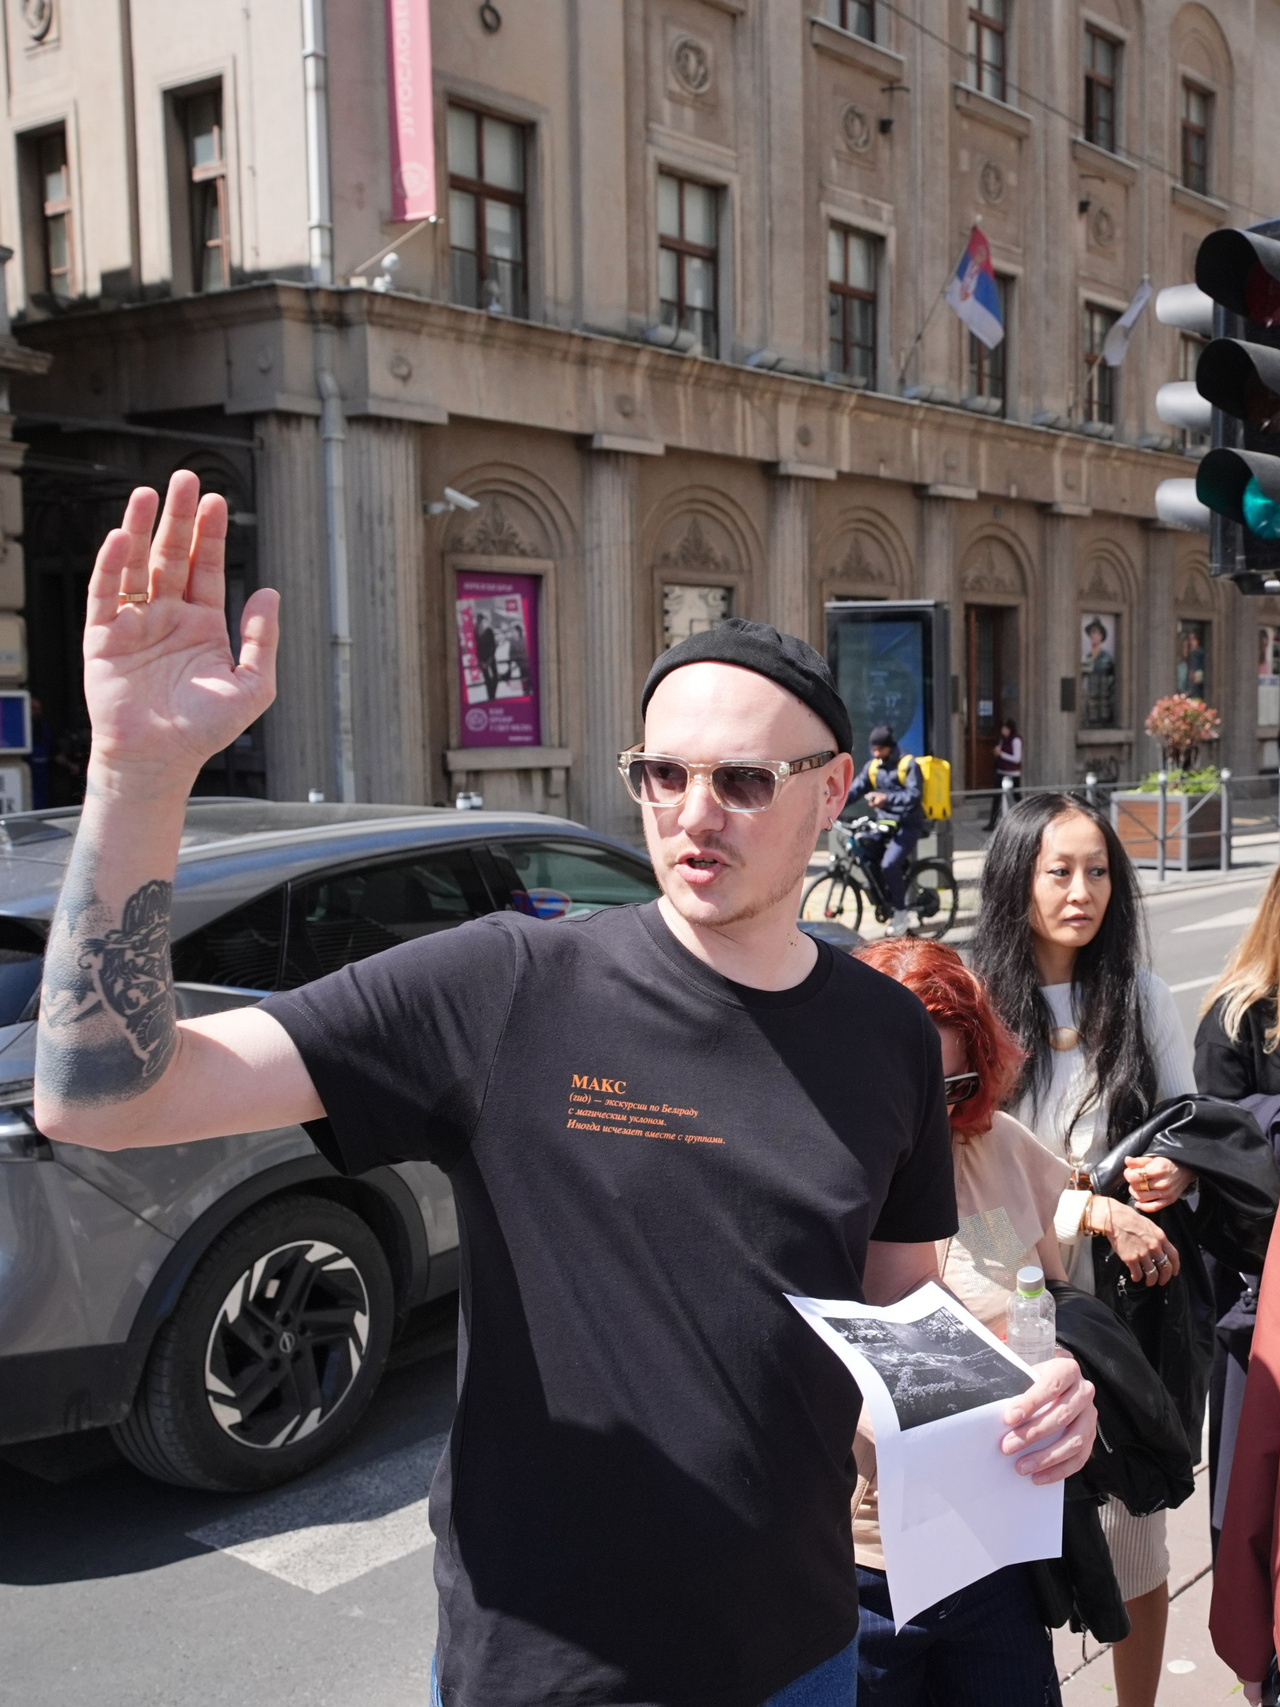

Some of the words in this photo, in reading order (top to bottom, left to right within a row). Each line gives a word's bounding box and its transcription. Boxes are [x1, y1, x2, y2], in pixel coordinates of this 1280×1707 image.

[571, 1074, 627, 1095] МАКС
[567, 1107, 575, 1115] с
[575, 1108, 627, 1121] магическим
[628, 1115, 667, 1126] уклоном.
[569, 1092, 592, 1105] (гид)
[604, 1099, 648, 1111] экскурсии
[649, 1104, 660, 1112] по
[661, 1103, 699, 1119] Белграду
[566, 1118, 601, 1132] Иногда
[602, 1125, 643, 1137] исчезает
[644, 1130, 676, 1140] вместе
[684, 1134, 726, 1145] группами.
